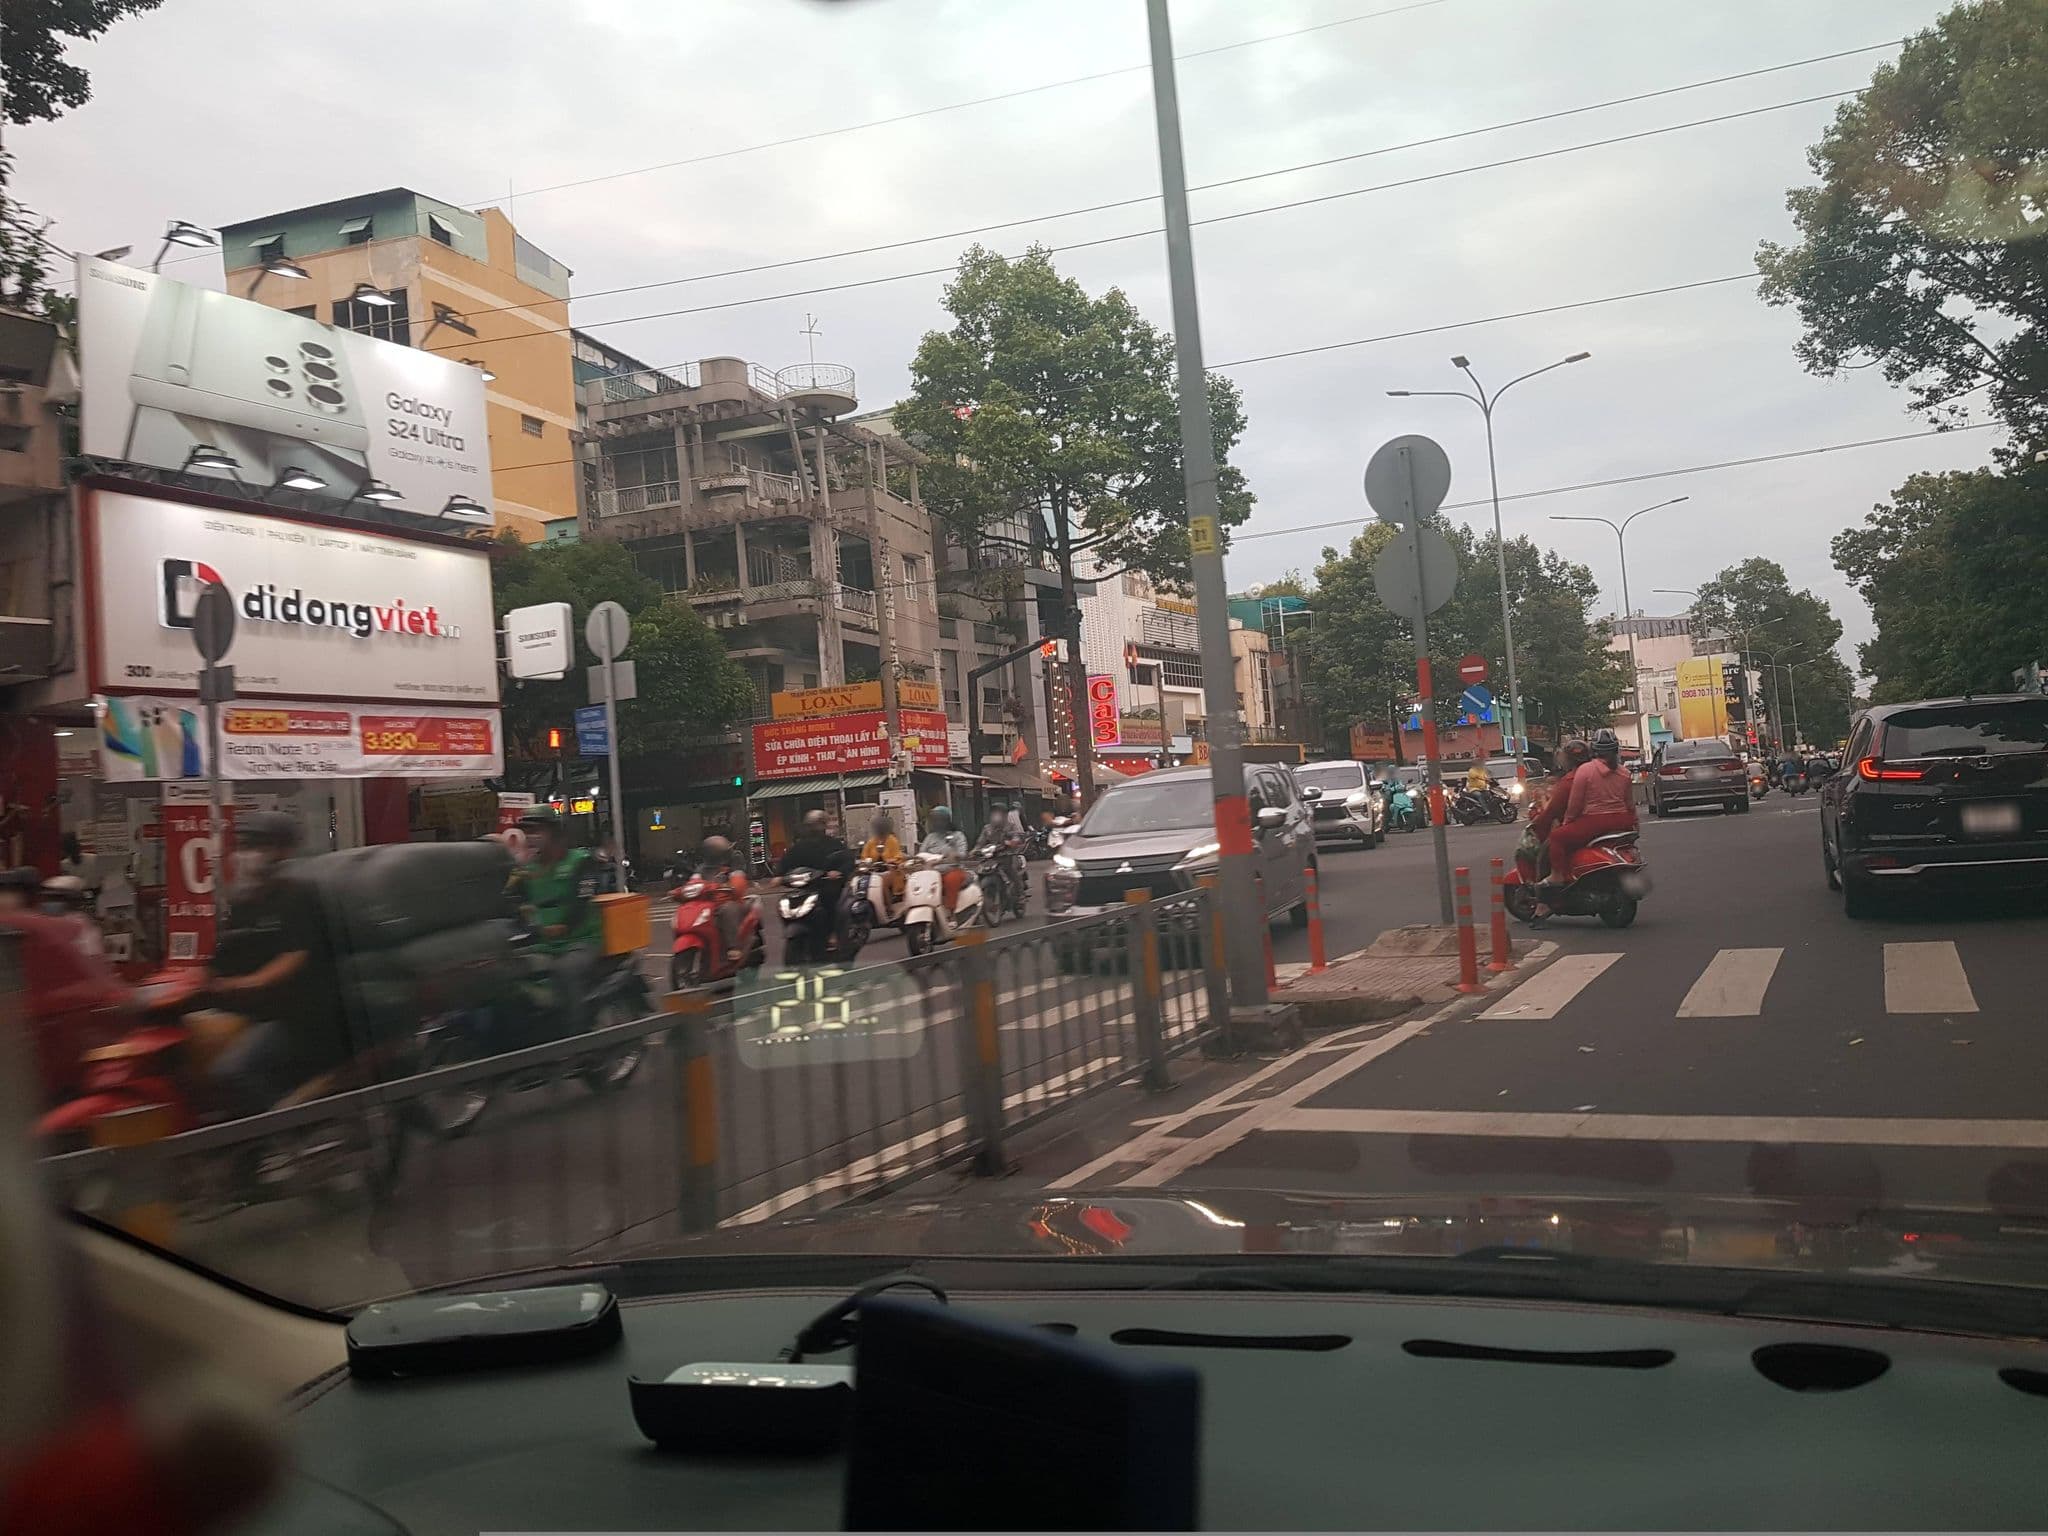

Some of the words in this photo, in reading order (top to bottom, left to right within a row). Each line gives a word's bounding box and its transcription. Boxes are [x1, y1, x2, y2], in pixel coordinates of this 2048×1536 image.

[386, 391, 453, 428] Galaxy
[387, 418, 420, 441] S24
[422, 426, 465, 452] Ultra
[801, 694, 853, 711] LOAN
[908, 689, 932, 702] LOAN
[808, 721, 835, 732] MOBILE
[765, 738, 782, 752] SỬA
[784, 736, 806, 750] CHỮA
[808, 735, 828, 748] ĐIỆN
[829, 733, 854, 746] THOẠI
[856, 730, 870, 743] LẤY
[777, 755, 788, 766] ÉP
[789, 753, 809, 764] KÍNH
[816, 750, 836, 762] THAY
[859, 745, 880, 758] HÌNH
[771, 968, 850, 1033] 26
